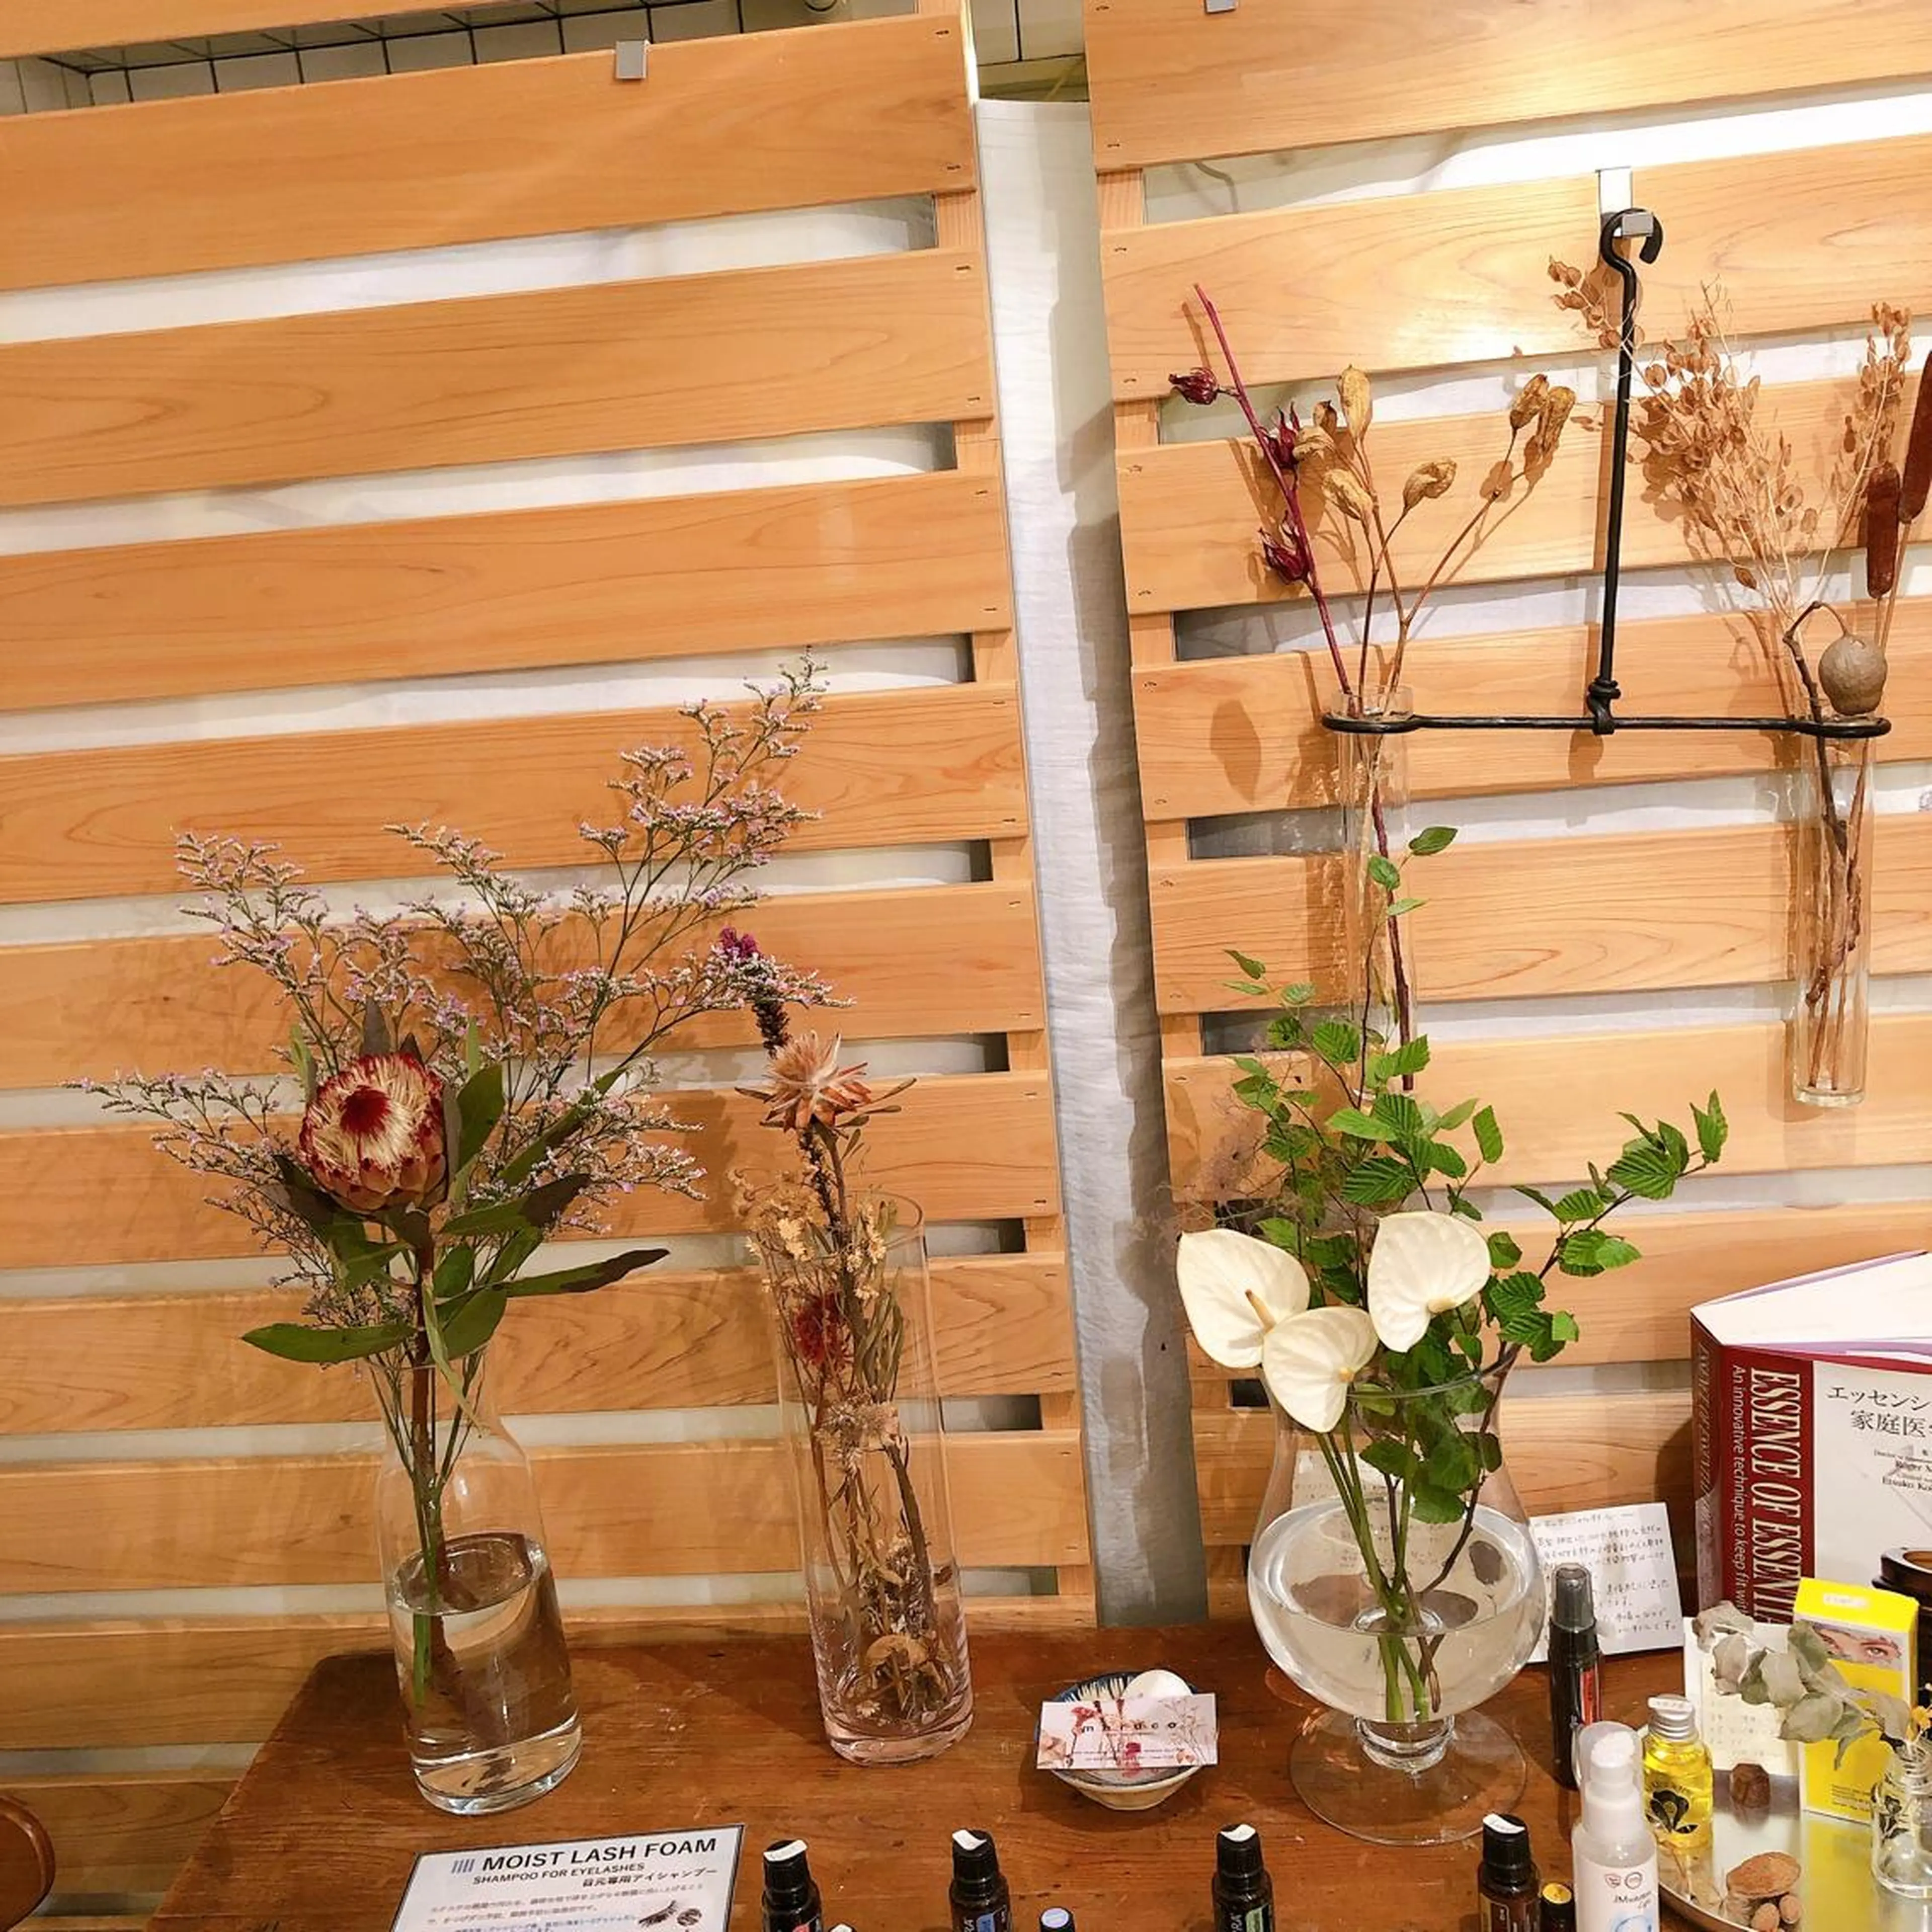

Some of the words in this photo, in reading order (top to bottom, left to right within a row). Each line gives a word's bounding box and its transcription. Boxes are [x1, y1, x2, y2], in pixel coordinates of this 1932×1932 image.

[1732, 1365, 1746, 1384] An
[1827, 1386, 1930, 1411] エッセンシ
[1732, 1387, 1747, 1454] innovative
[1751, 1367, 1801, 1479] ESSENCE
[1731, 1456, 1748, 1519] technique
[1751, 1482, 1802, 1519] OF
[1734, 1523, 1748, 1537] to
[1732, 1539, 1749, 1570] keep
[1735, 1572, 1750, 1587] fit
[482, 1852, 565, 1871] MOIST
[571, 1845, 636, 1864] LASH
[643, 1838, 716, 1858] FOAM
[473, 1871, 538, 1885] SHAMPOO
[541, 1869, 568, 1879] FOR
[571, 1862, 645, 1877] EYELASHES
